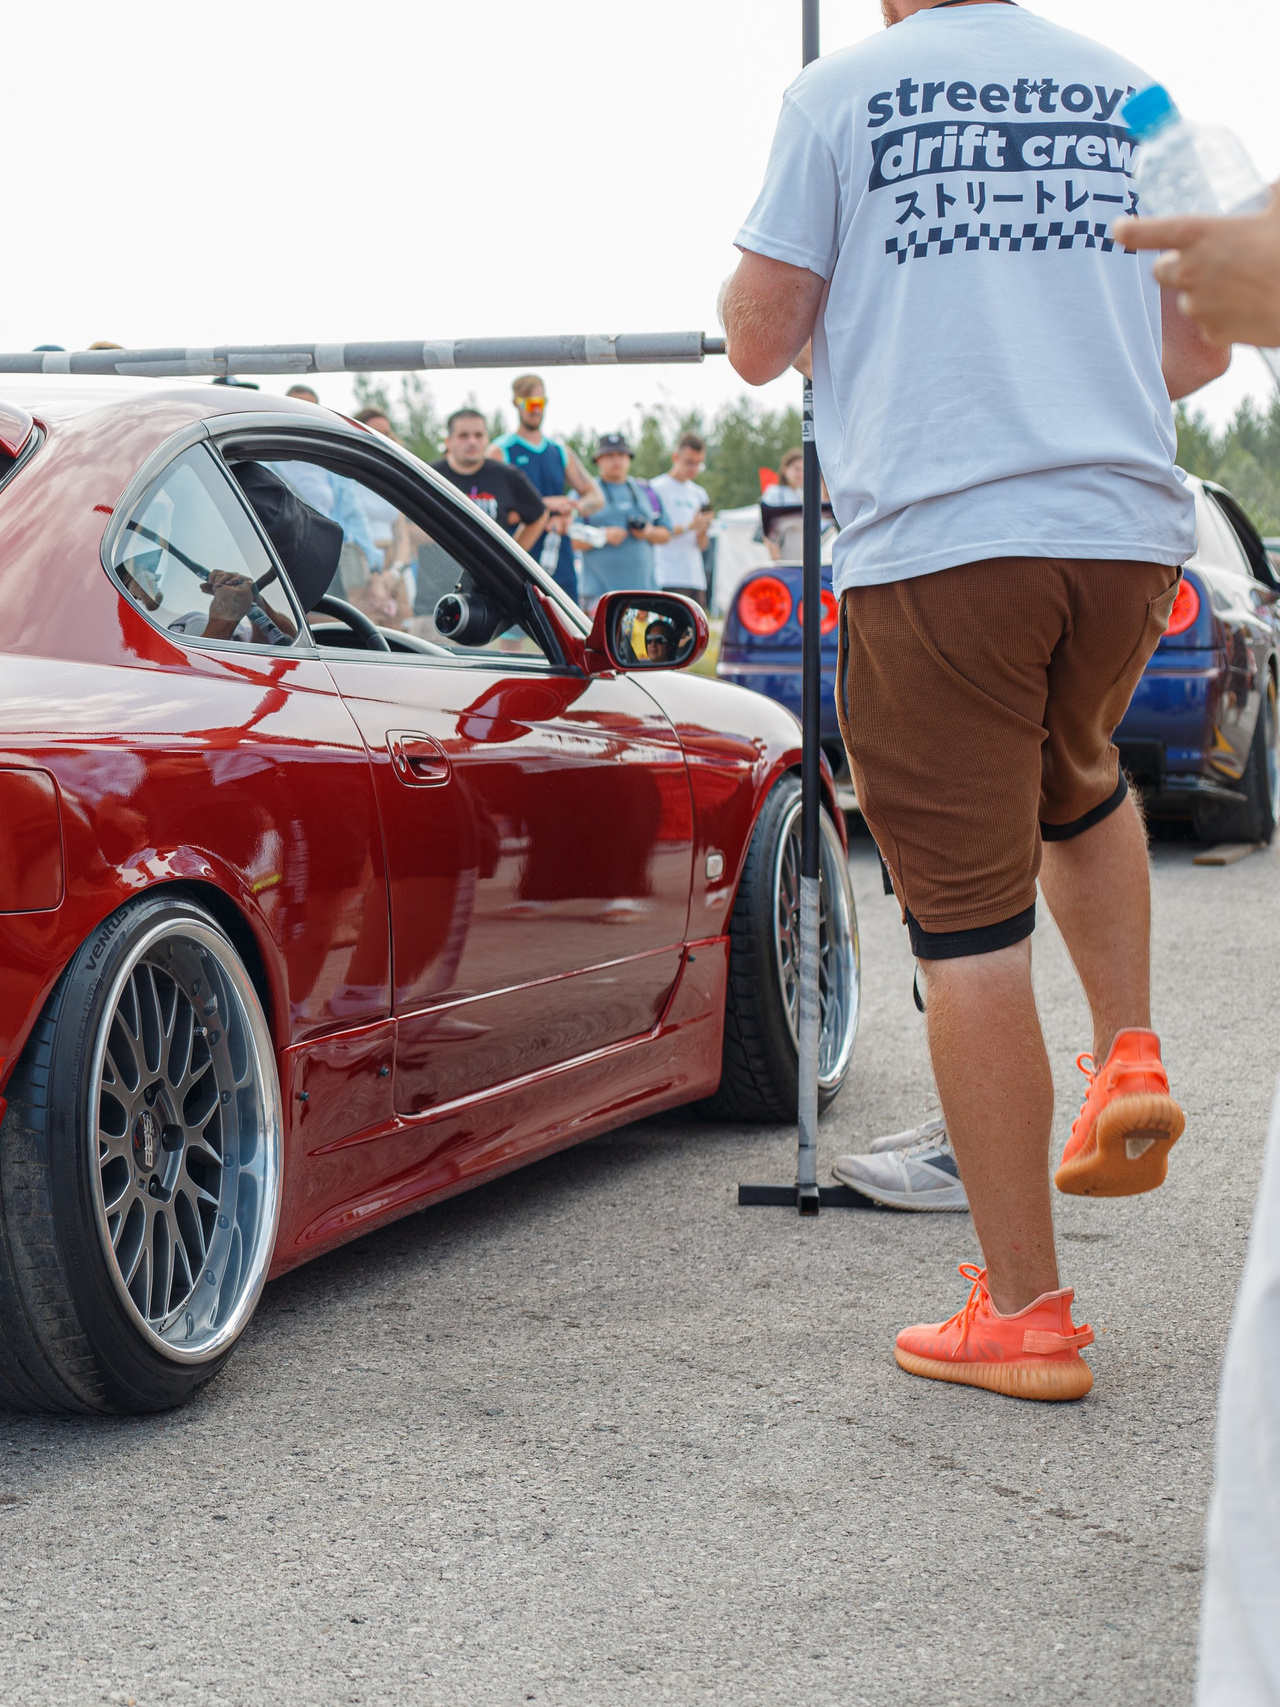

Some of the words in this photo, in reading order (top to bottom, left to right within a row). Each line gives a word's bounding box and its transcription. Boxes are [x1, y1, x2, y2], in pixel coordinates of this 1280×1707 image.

[880, 124, 1007, 180] drift
[1022, 134, 1141, 173] crew
[143, 1113, 154, 1168] BBS
